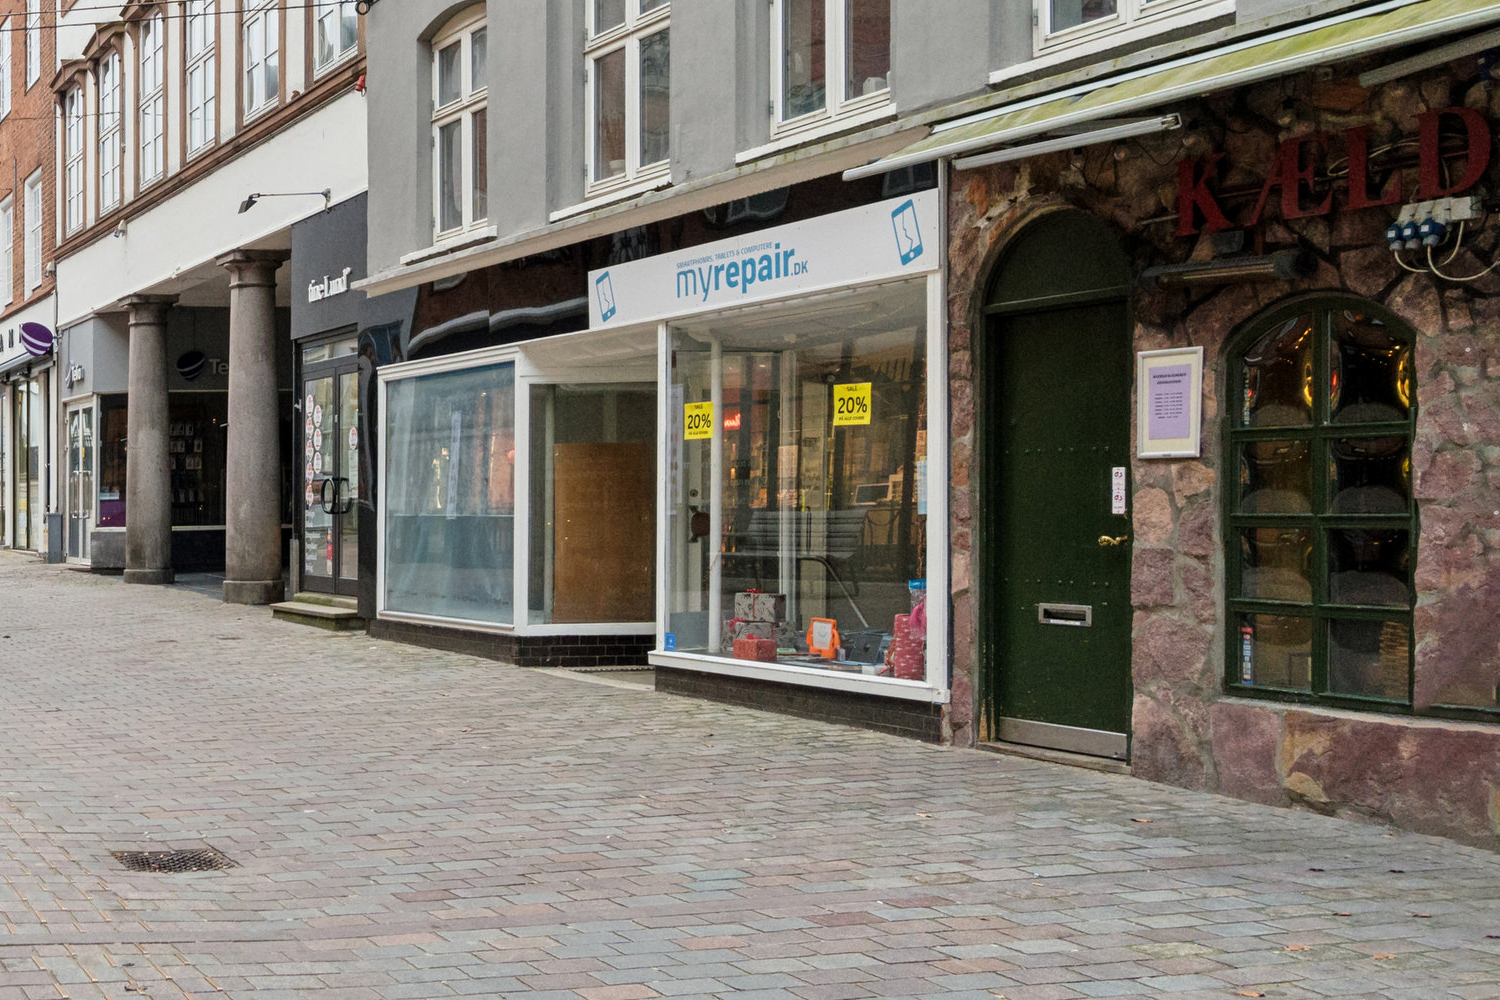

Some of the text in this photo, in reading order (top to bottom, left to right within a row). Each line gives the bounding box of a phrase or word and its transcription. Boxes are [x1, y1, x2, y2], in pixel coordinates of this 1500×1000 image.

[1176, 106, 1492, 237] KÆLD
[838, 396, 868, 414] 20%
[687, 413, 712, 430] 20%
